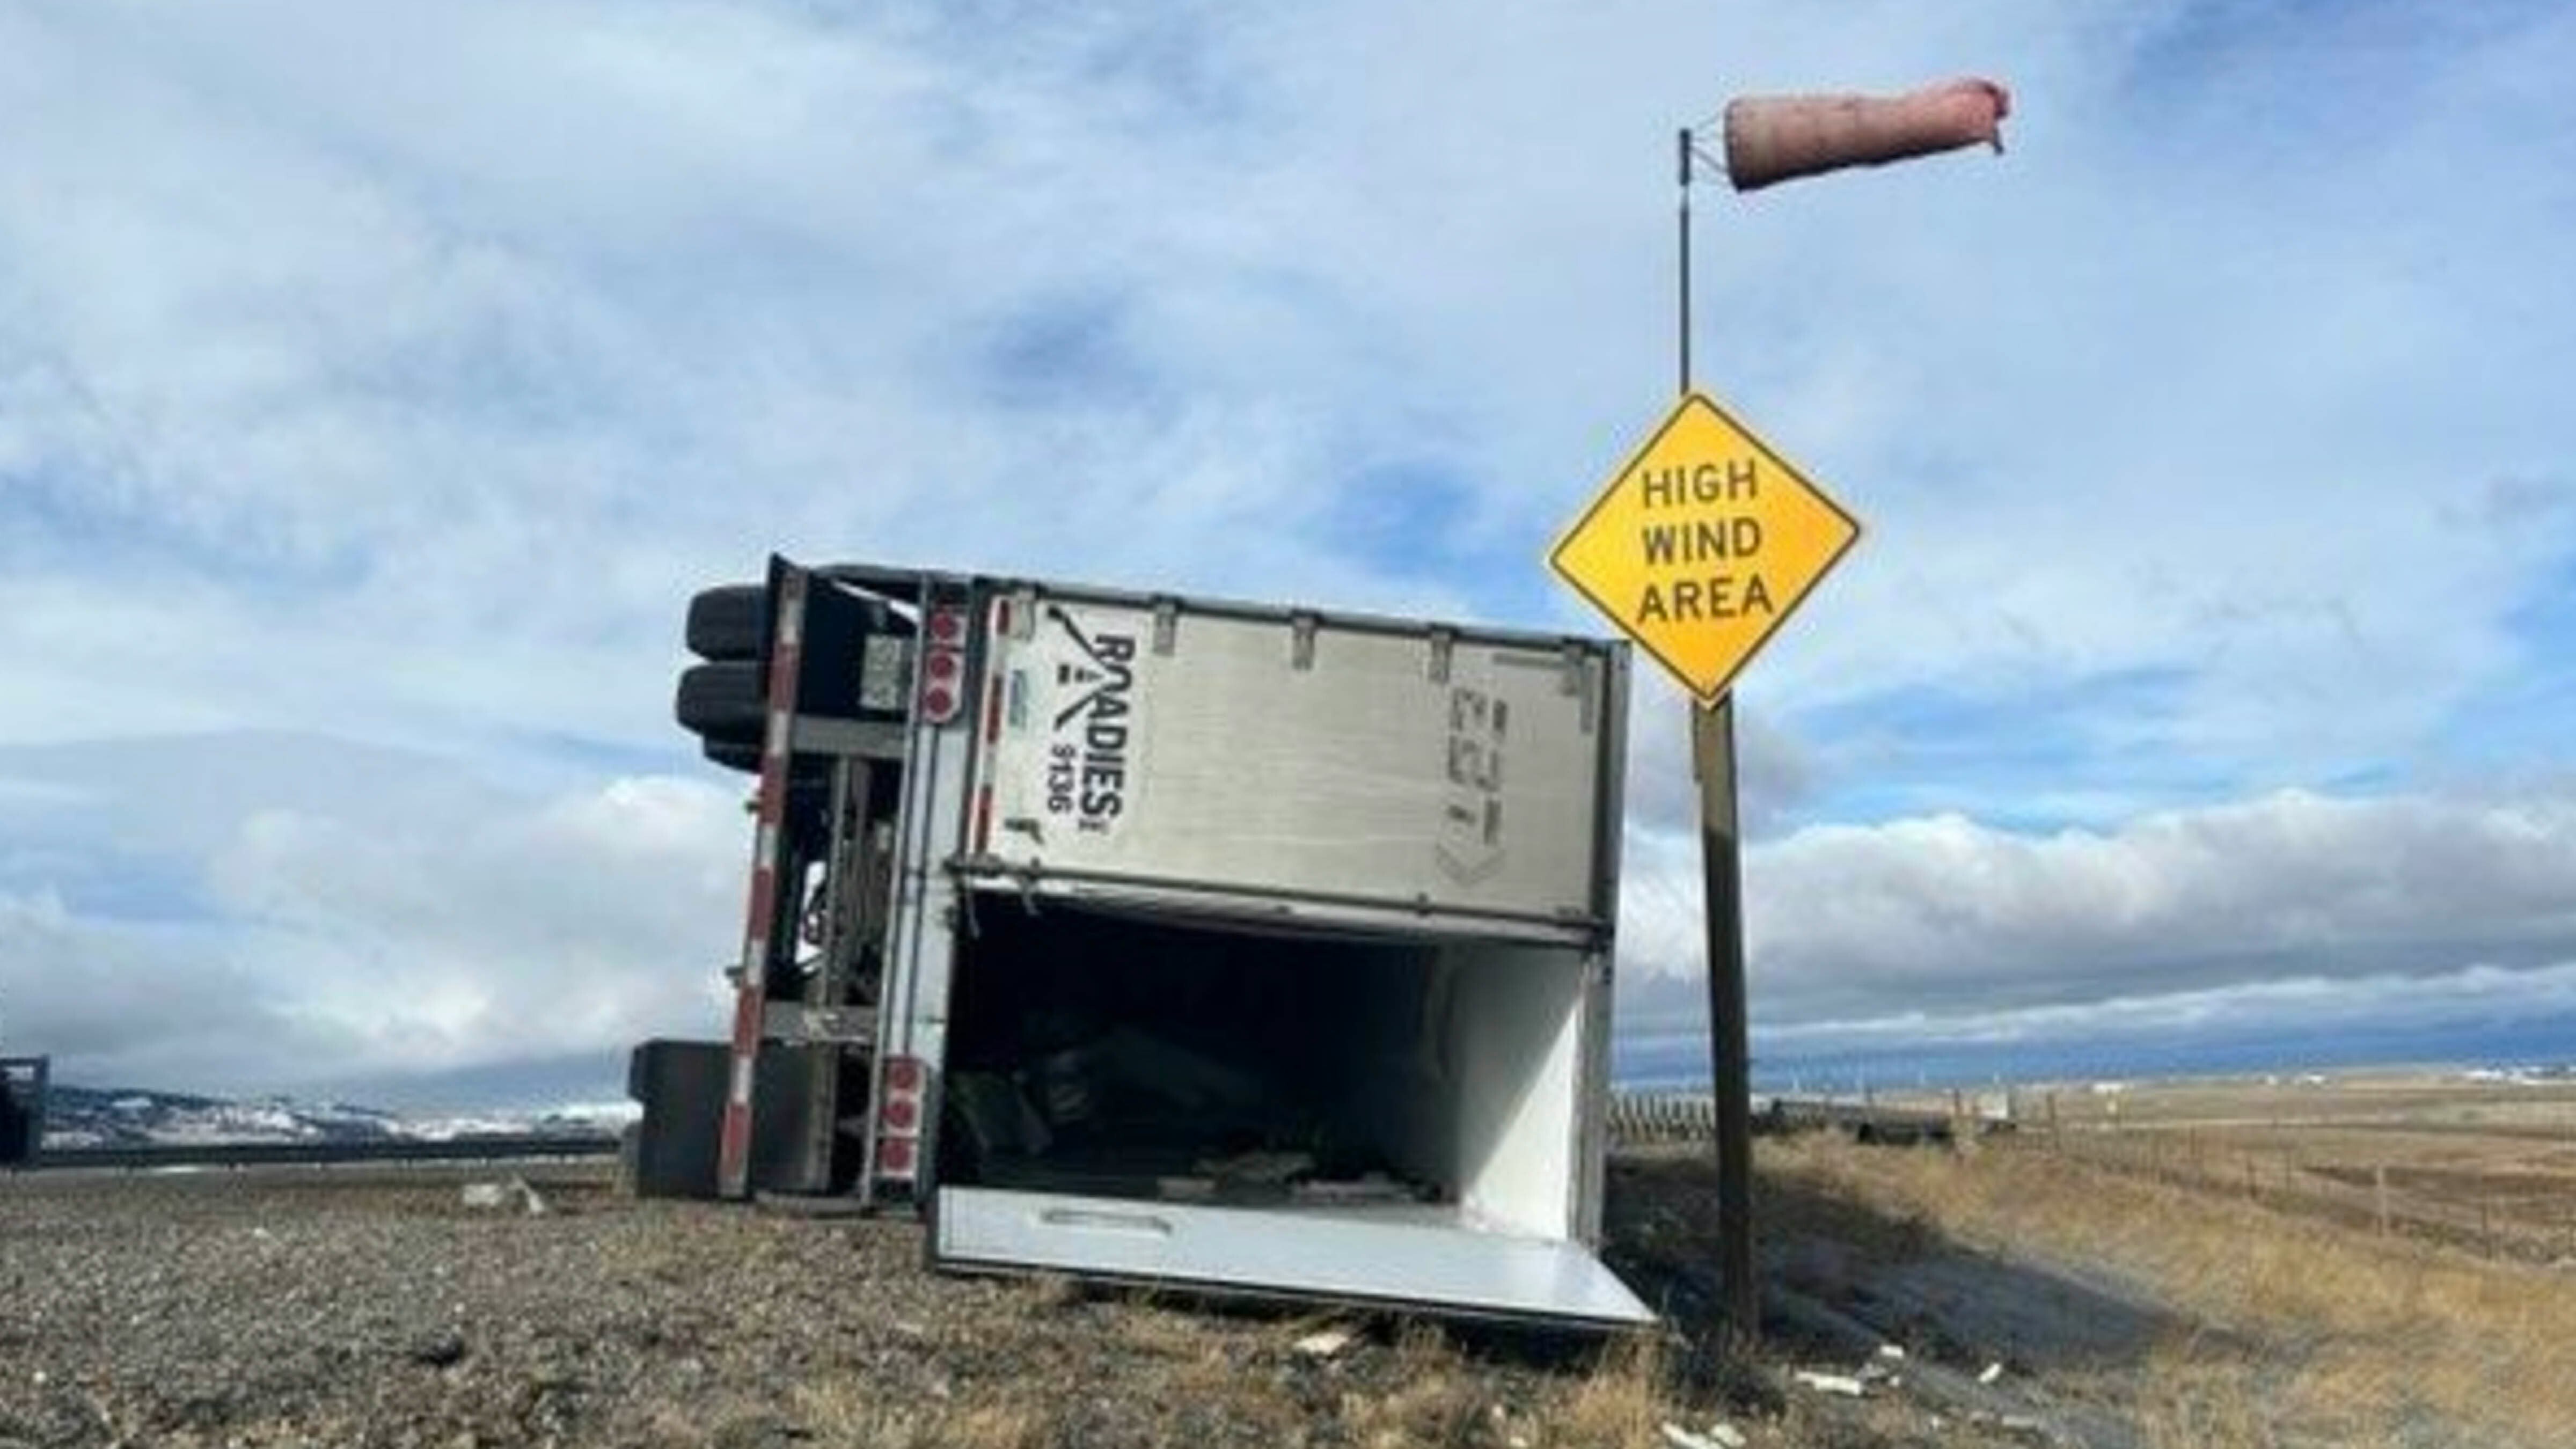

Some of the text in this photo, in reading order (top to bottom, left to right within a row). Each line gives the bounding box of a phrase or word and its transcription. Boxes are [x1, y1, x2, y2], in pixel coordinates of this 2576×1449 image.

[1642, 457, 1759, 509] HIGH
[1642, 517, 1762, 565] WIND
[1636, 573, 1774, 625] AREA
[1079, 634, 1136, 816] ROADIES
[1046, 743, 1077, 815] 9136
